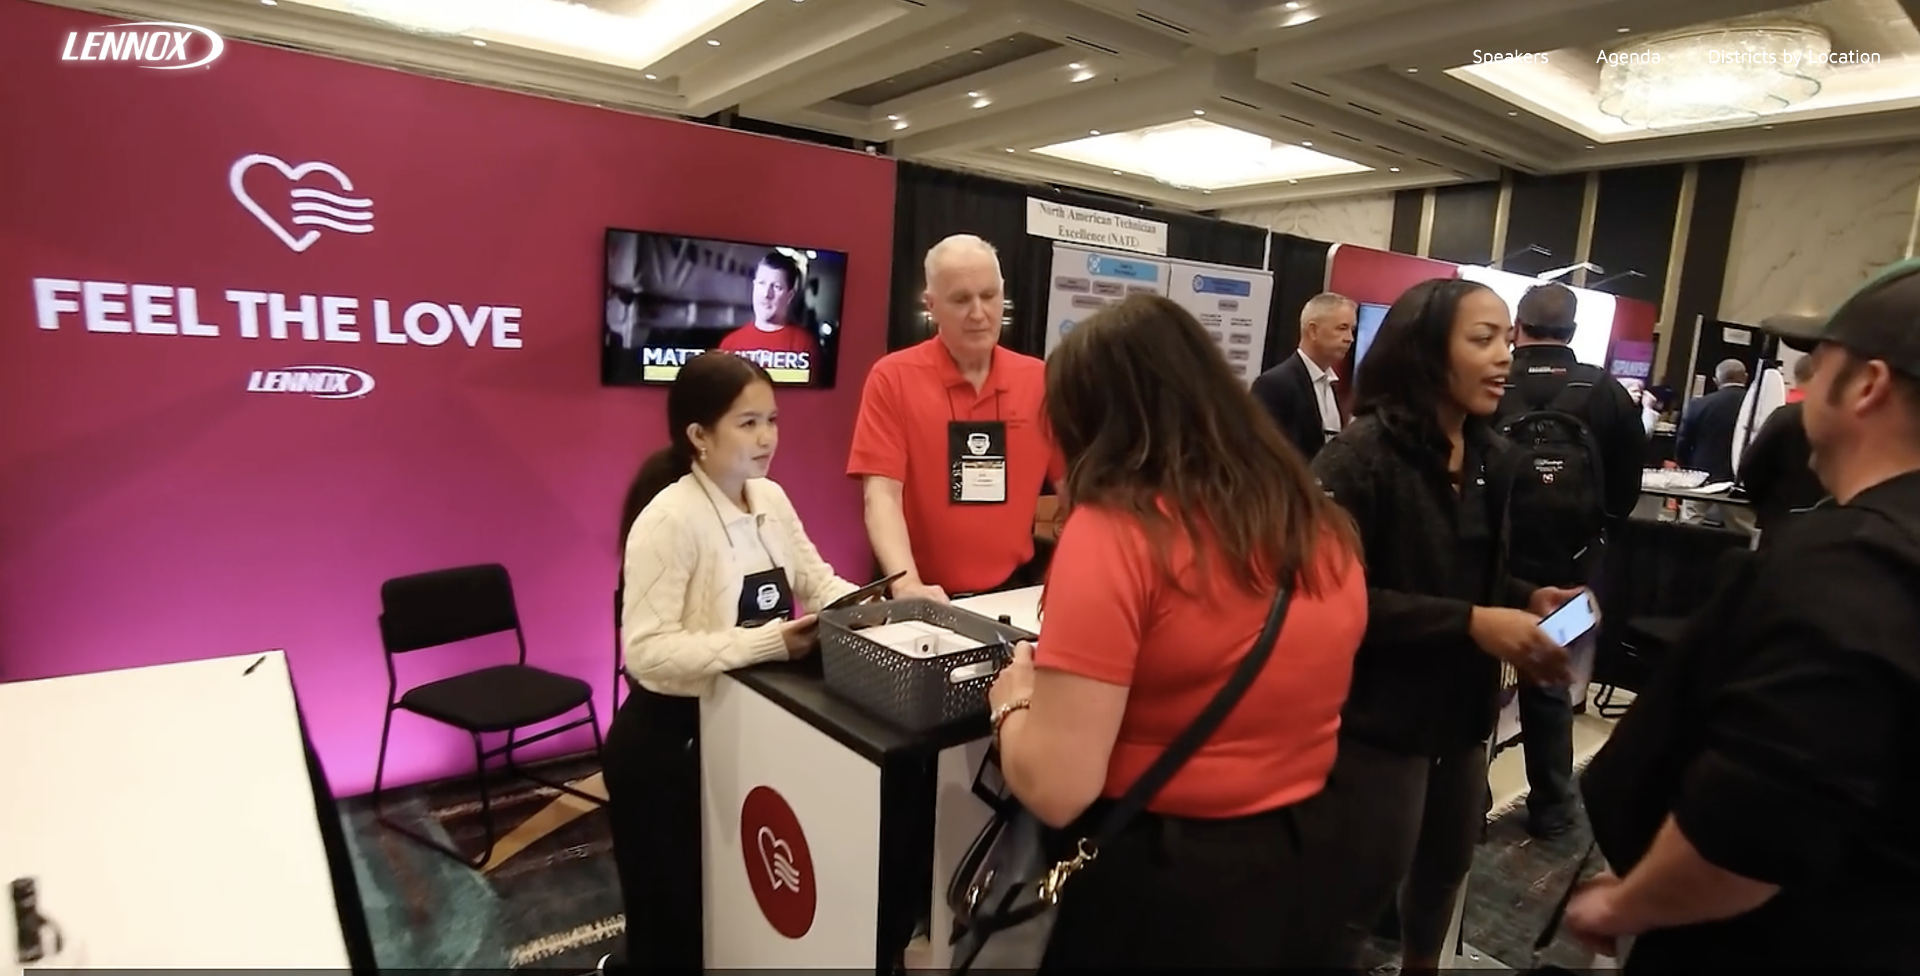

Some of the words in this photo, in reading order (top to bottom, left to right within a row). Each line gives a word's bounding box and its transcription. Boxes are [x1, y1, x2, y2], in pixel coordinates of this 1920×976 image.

[1040, 202, 1065, 219] North
[1067, 209, 1113, 226] American
[1114, 215, 1157, 234] Technician
[1058, 224, 1106, 242] Excellence
[1105, 233, 1140, 248] (NATE)
[32, 277, 220, 337] FEEL
[225, 289, 361, 343] THE
[373, 299, 523, 349] LOVE
[246, 370, 352, 393] LENNOX
